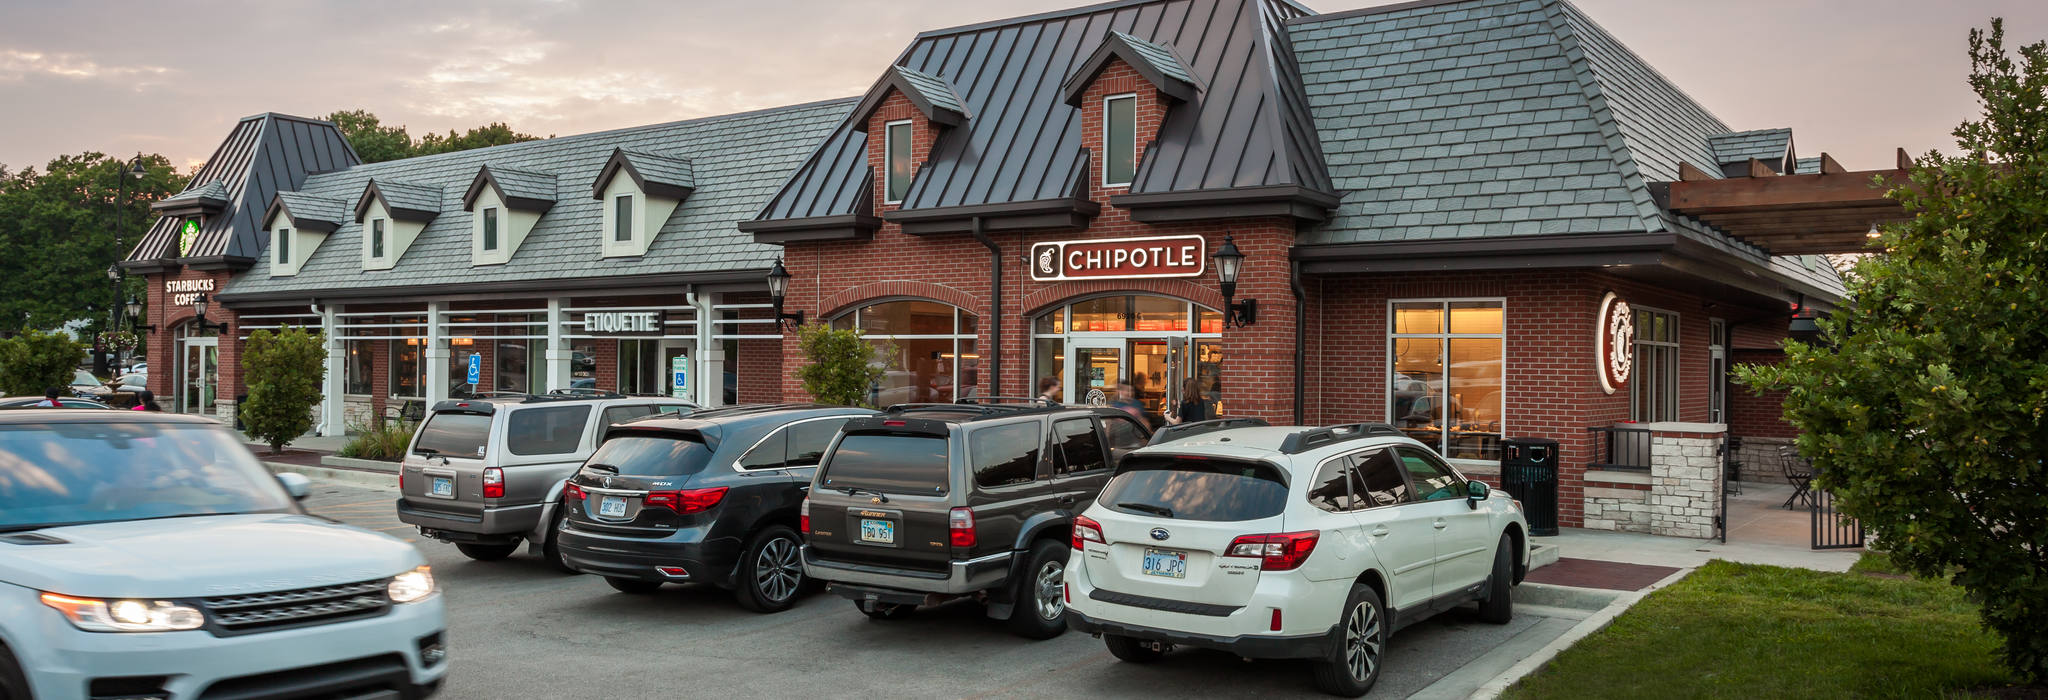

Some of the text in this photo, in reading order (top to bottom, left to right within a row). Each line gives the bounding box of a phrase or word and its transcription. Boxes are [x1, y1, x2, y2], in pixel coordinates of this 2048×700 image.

[1068, 245, 1196, 270] CHIPOTLE
[166, 279, 214, 293] STARBUCKS
[174, 292, 206, 306] COFF
[584, 312, 660, 332] ETIQUETTE
[1145, 557, 1183, 573] 316 JPC
